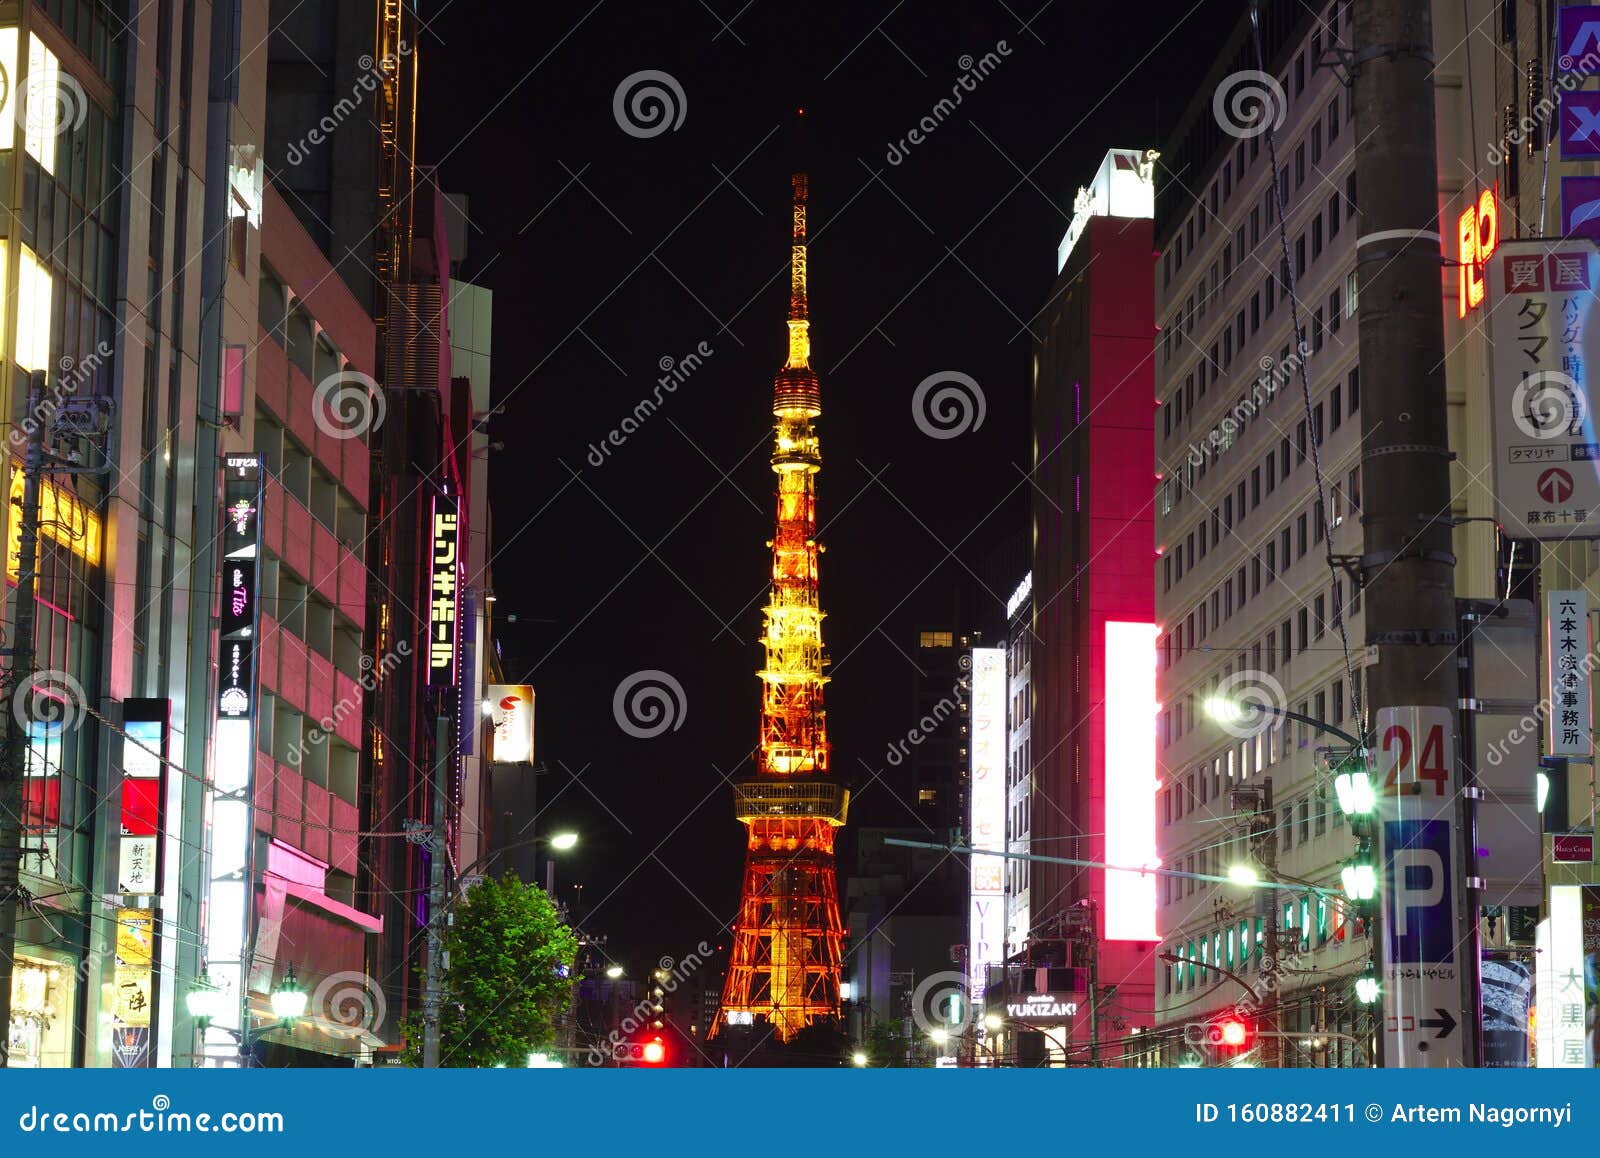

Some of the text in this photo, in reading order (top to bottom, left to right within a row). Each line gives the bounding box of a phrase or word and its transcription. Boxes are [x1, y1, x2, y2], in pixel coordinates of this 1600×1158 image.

[1511, 258, 1586, 288] 質屋
[1527, 509, 1588, 524] 麻布十番
[1559, 599, 1580, 745] 六本木法律事務所
[1383, 724, 1449, 796] 24
[130, 844, 145, 883] 新天地
[1393, 849, 1445, 936] P
[121, 982, 147, 1012] 一陣
[1560, 967, 1584, 1065] 大黒屋
